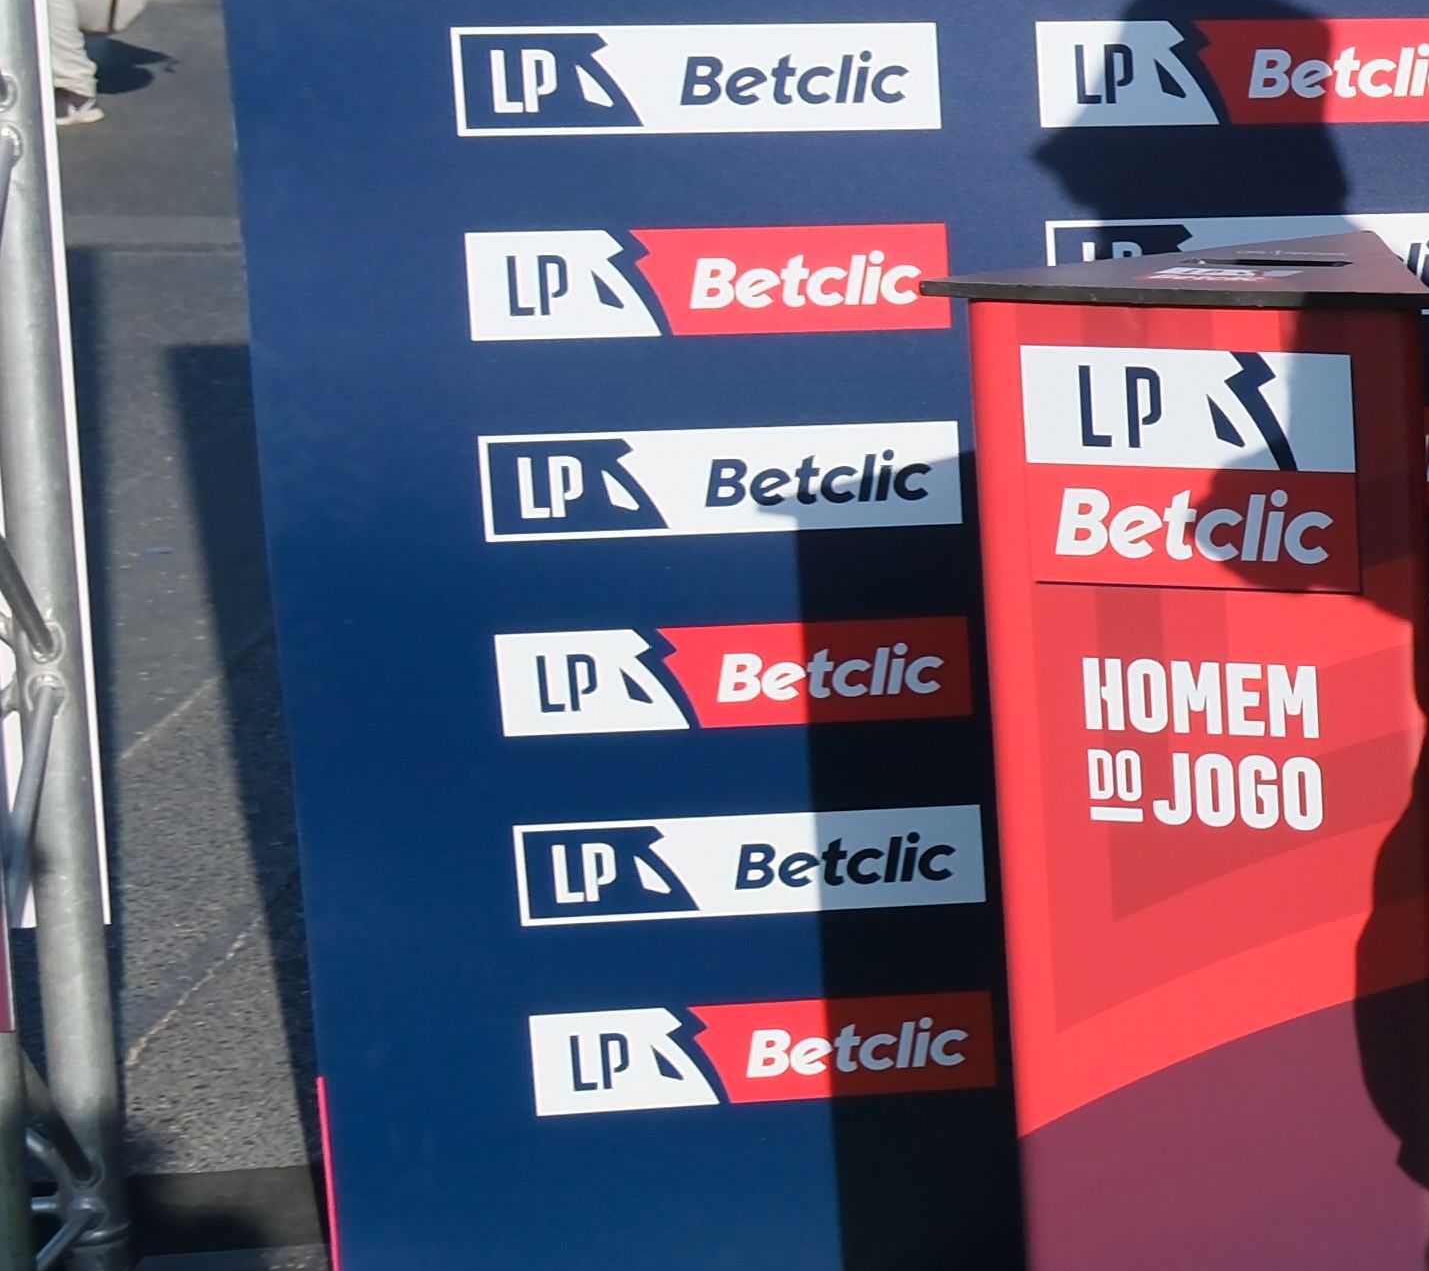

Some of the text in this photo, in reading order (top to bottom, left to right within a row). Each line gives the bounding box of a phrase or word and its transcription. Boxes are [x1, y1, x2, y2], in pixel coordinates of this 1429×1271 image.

[490, 48, 909, 113] LP Betclic
[1074, 43, 1134, 104] LP
[506, 249, 922, 317] LP Betclic
[1078, 364, 1162, 449] LP
[516, 449, 932, 519] LP Betclic
[1054, 486, 1333, 565] Betclic
[535, 642, 945, 713] LP Betclic
[1083, 657, 1321, 740] HOMEM
[1087, 747, 1325, 831] DO JOGO
[551, 831, 957, 904] LP Betclic
[570, 1016, 969, 1092] LP Betclic
